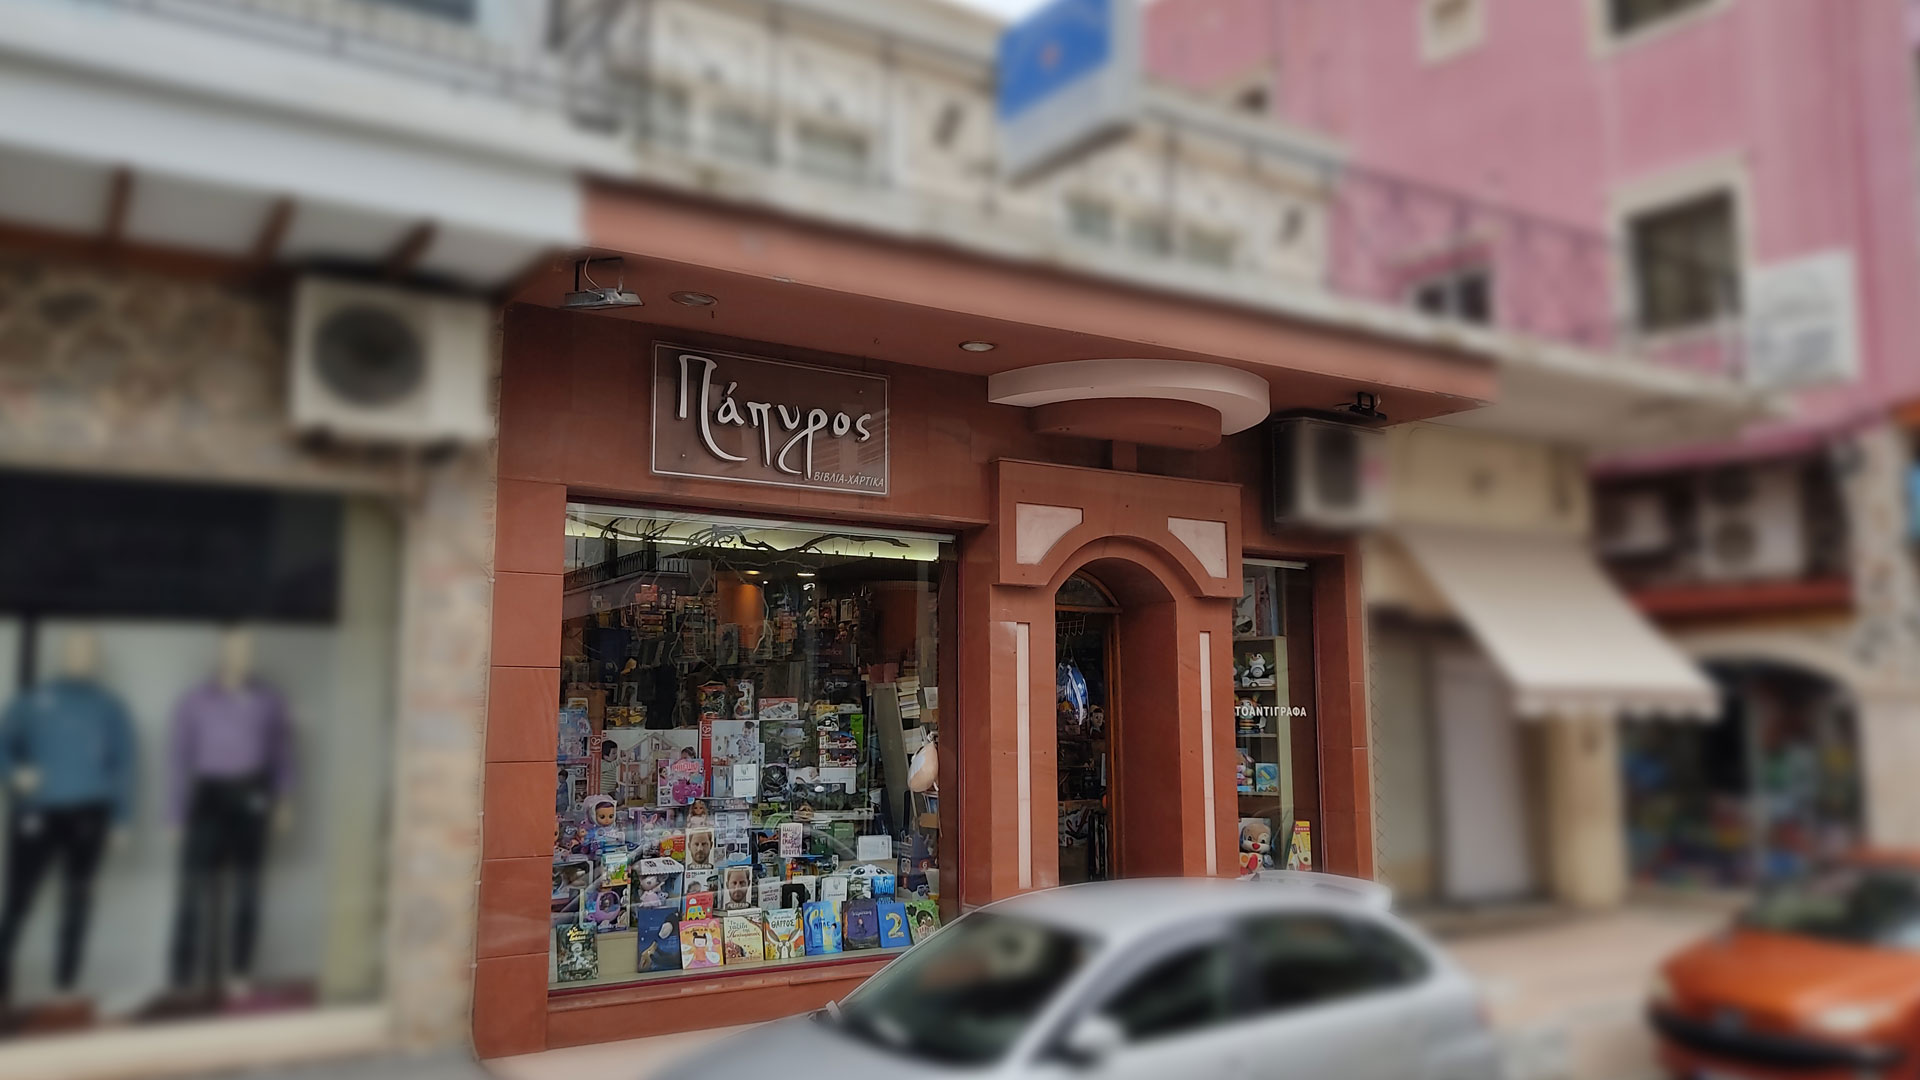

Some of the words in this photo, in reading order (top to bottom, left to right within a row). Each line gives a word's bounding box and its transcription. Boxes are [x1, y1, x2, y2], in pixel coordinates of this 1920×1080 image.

[678, 354, 872, 479] Πάπυρος
[1234, 706, 1307, 717] ΤΟΑΝΤΙΓΡΑΦΑ
[886, 912, 905, 939] 2
